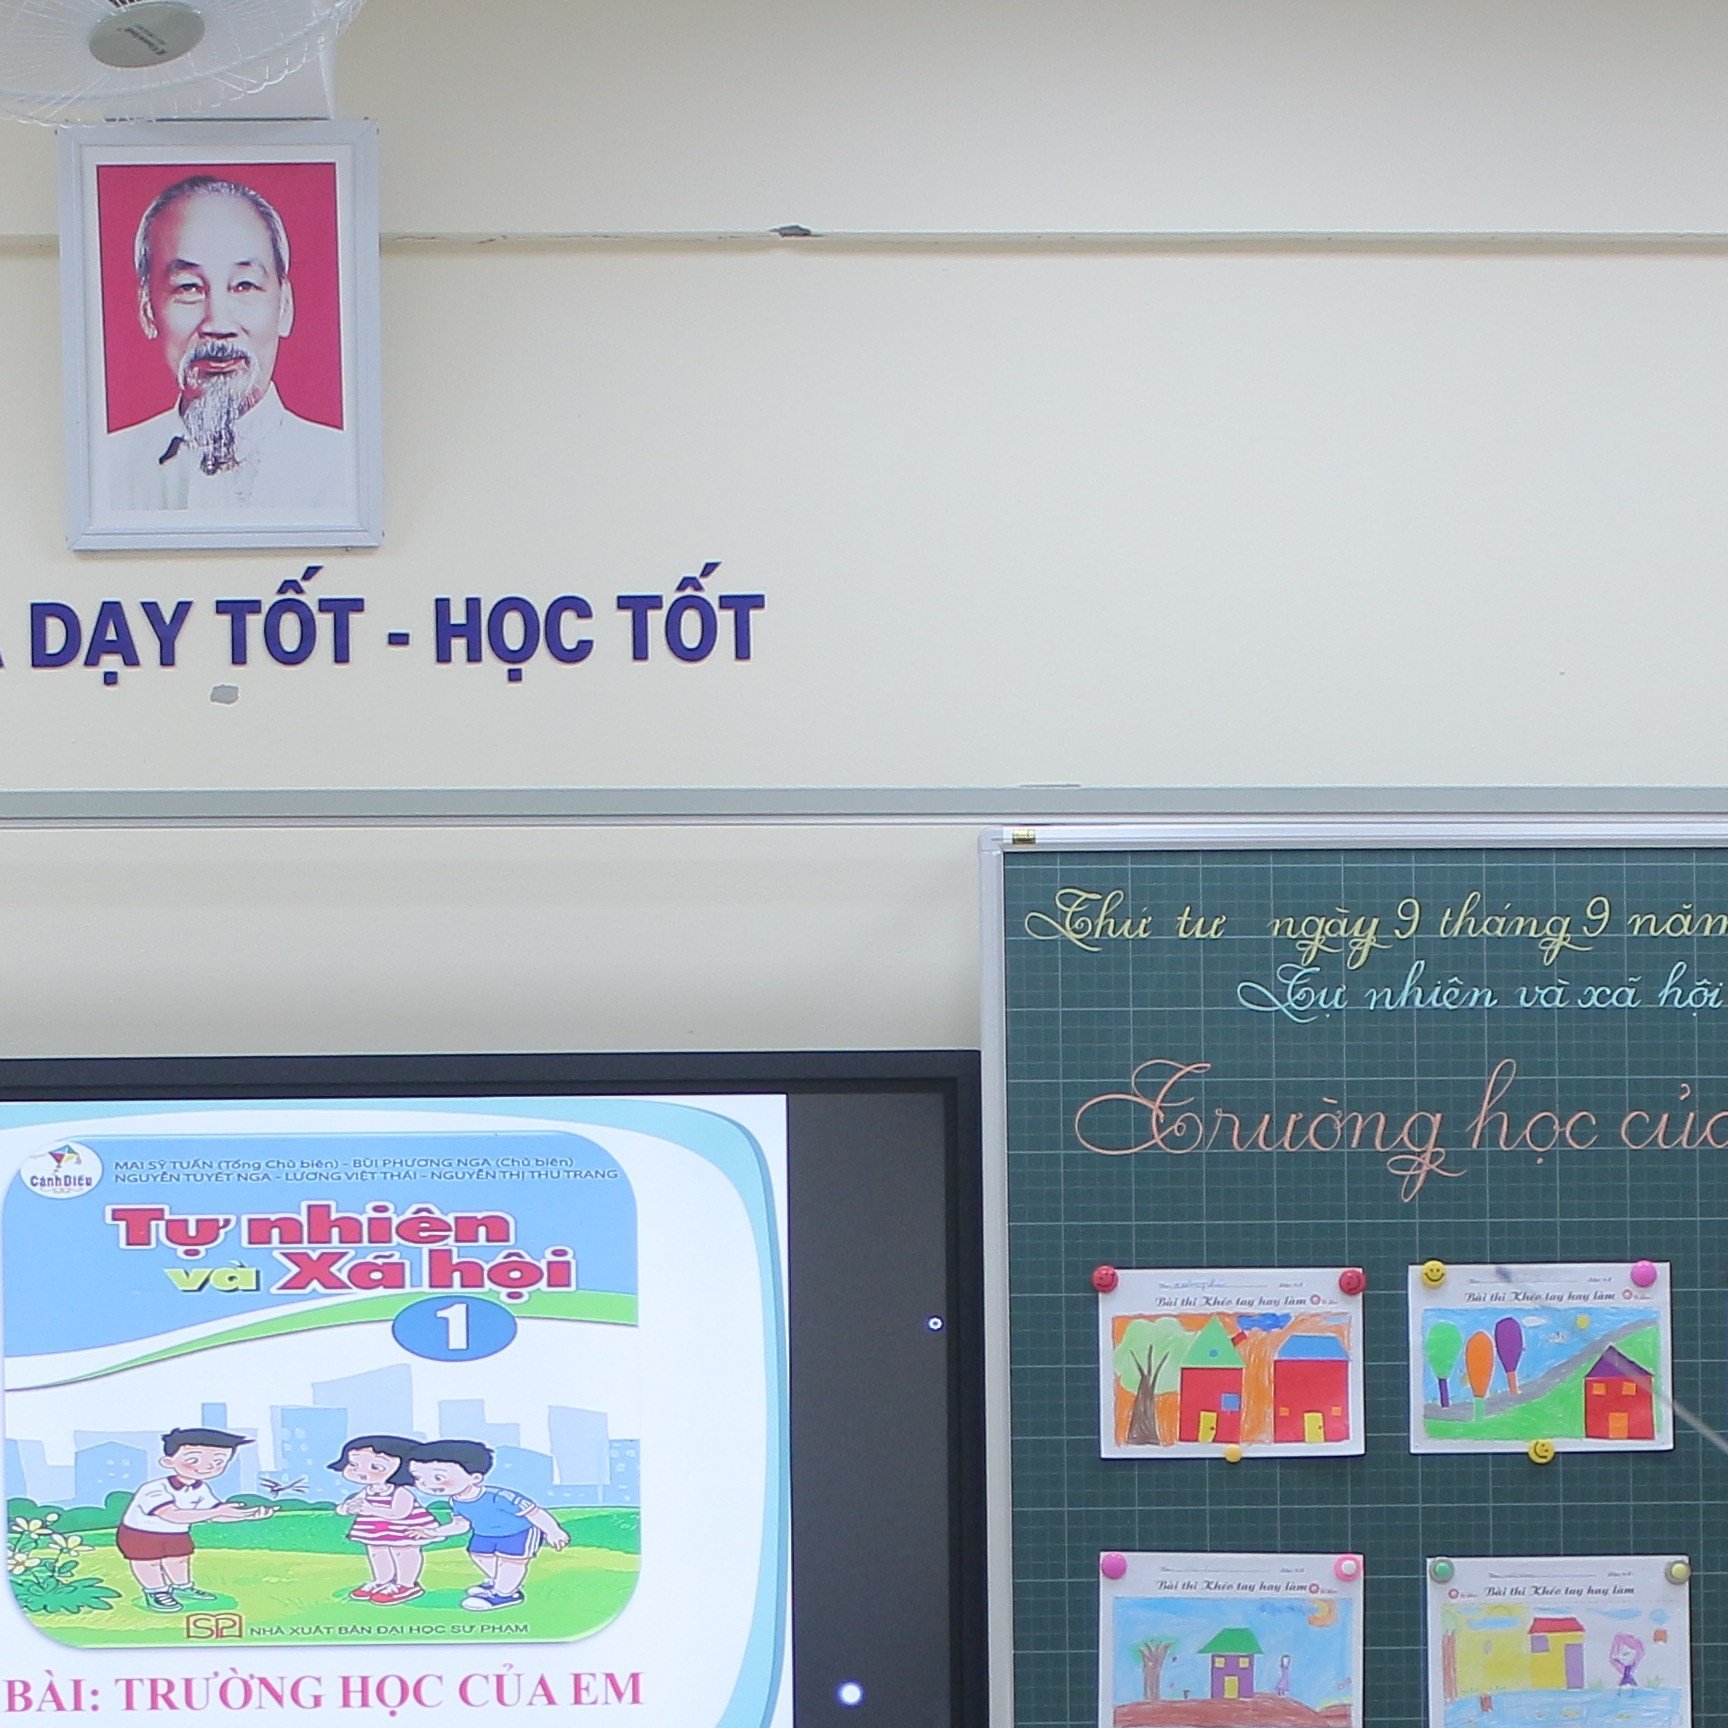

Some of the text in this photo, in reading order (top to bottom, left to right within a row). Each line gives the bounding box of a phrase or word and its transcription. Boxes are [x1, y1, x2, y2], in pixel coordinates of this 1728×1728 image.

[30, 600, 193, 686] DẠY
[216, 564, 364, 666] TỐT
[433, 594, 594, 683] HỌC
[616, 561, 765, 662] TỐT
[1025, 888, 1152, 952] Thứ
[1176, 906, 1227, 940] tư
[1270, 907, 1393, 970] ngày
[1393, 898, 1420, 940] 9
[1439, 892, 1594, 966] tháng
[1582, 896, 1611, 937] 9
[1237, 960, 1725, 1024] Tự nhiên và xã hội
[1074, 1059, 1467, 1202] Trường
[1465, 1059, 1599, 1165] học
[115, 1160, 144, 1171] MAI
[111, 1204, 510, 1256] Tự nhiên
[165, 1247, 572, 1300] và Xã hội
[436, 1303, 470, 1350] 1
[3, 1663, 645, 1717] BÀI: TRƯỜNG HỌC CỦA EM
